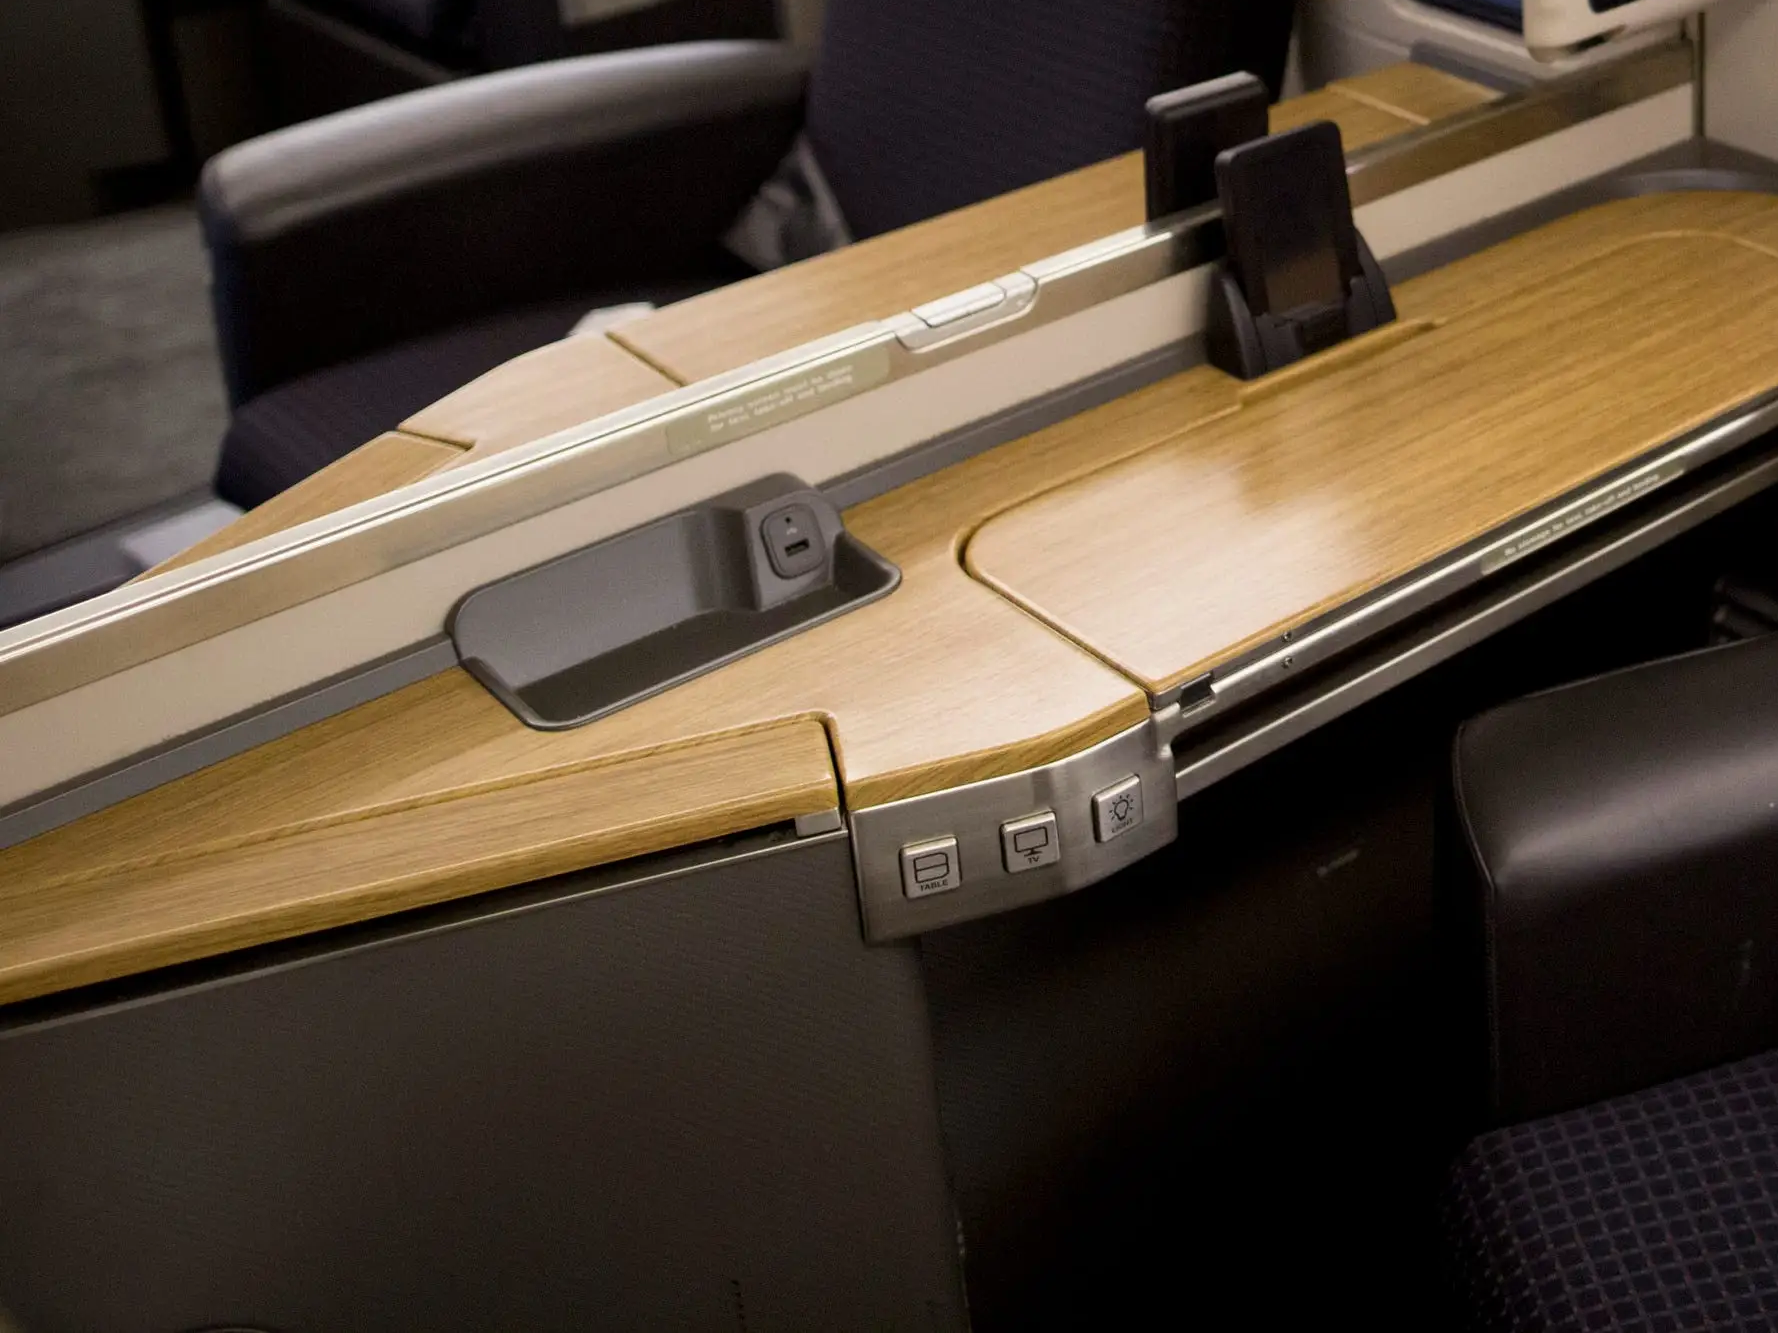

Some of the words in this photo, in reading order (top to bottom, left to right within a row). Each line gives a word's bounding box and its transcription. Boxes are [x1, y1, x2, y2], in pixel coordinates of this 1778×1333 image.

[1112, 818, 1133, 834] LIGHT
[1027, 856, 1040, 864] TV
[920, 879, 948, 892] TABLE
